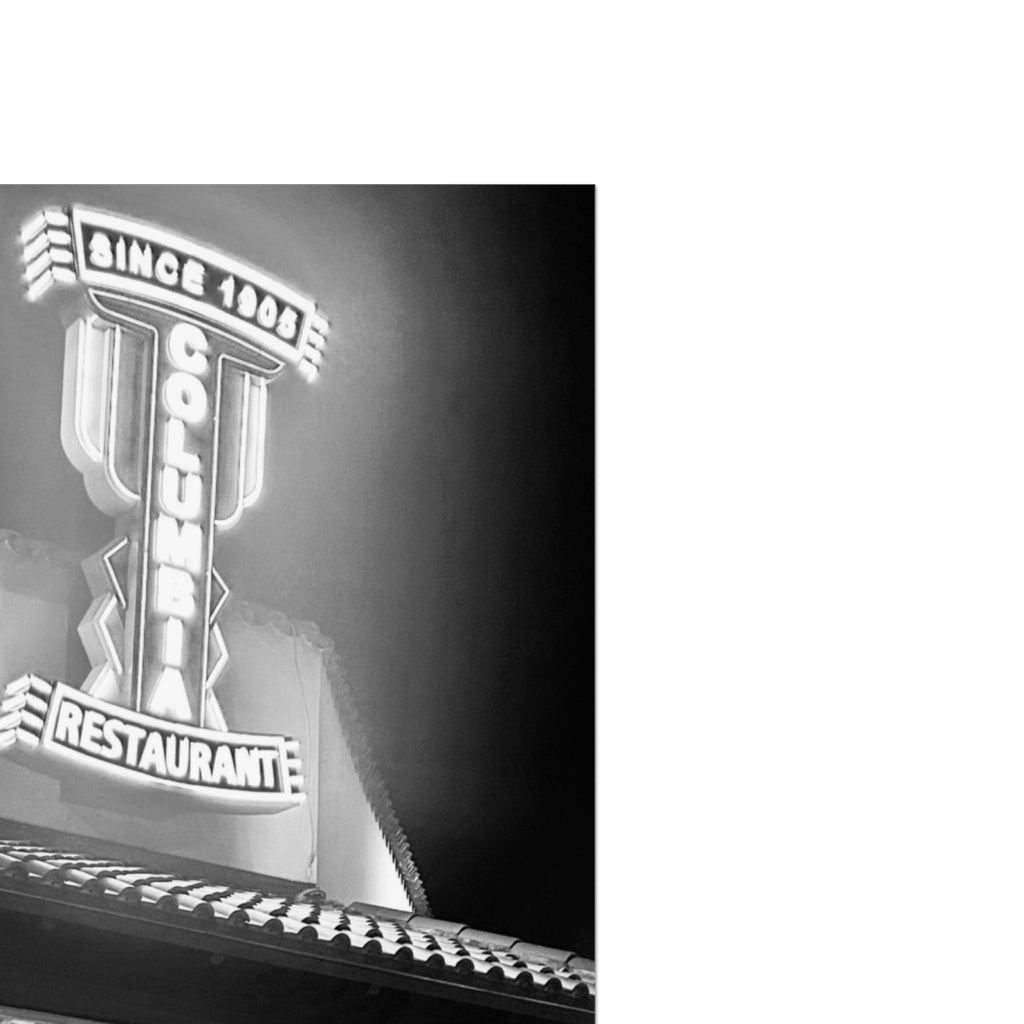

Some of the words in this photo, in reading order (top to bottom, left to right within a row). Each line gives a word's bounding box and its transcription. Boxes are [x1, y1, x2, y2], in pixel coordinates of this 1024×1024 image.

[88, 231, 205, 297] SINCE
[217, 273, 297, 340] 1905
[144, 320, 209, 721] COLUMBIA
[53, 697, 282, 788] RESTAURANT
